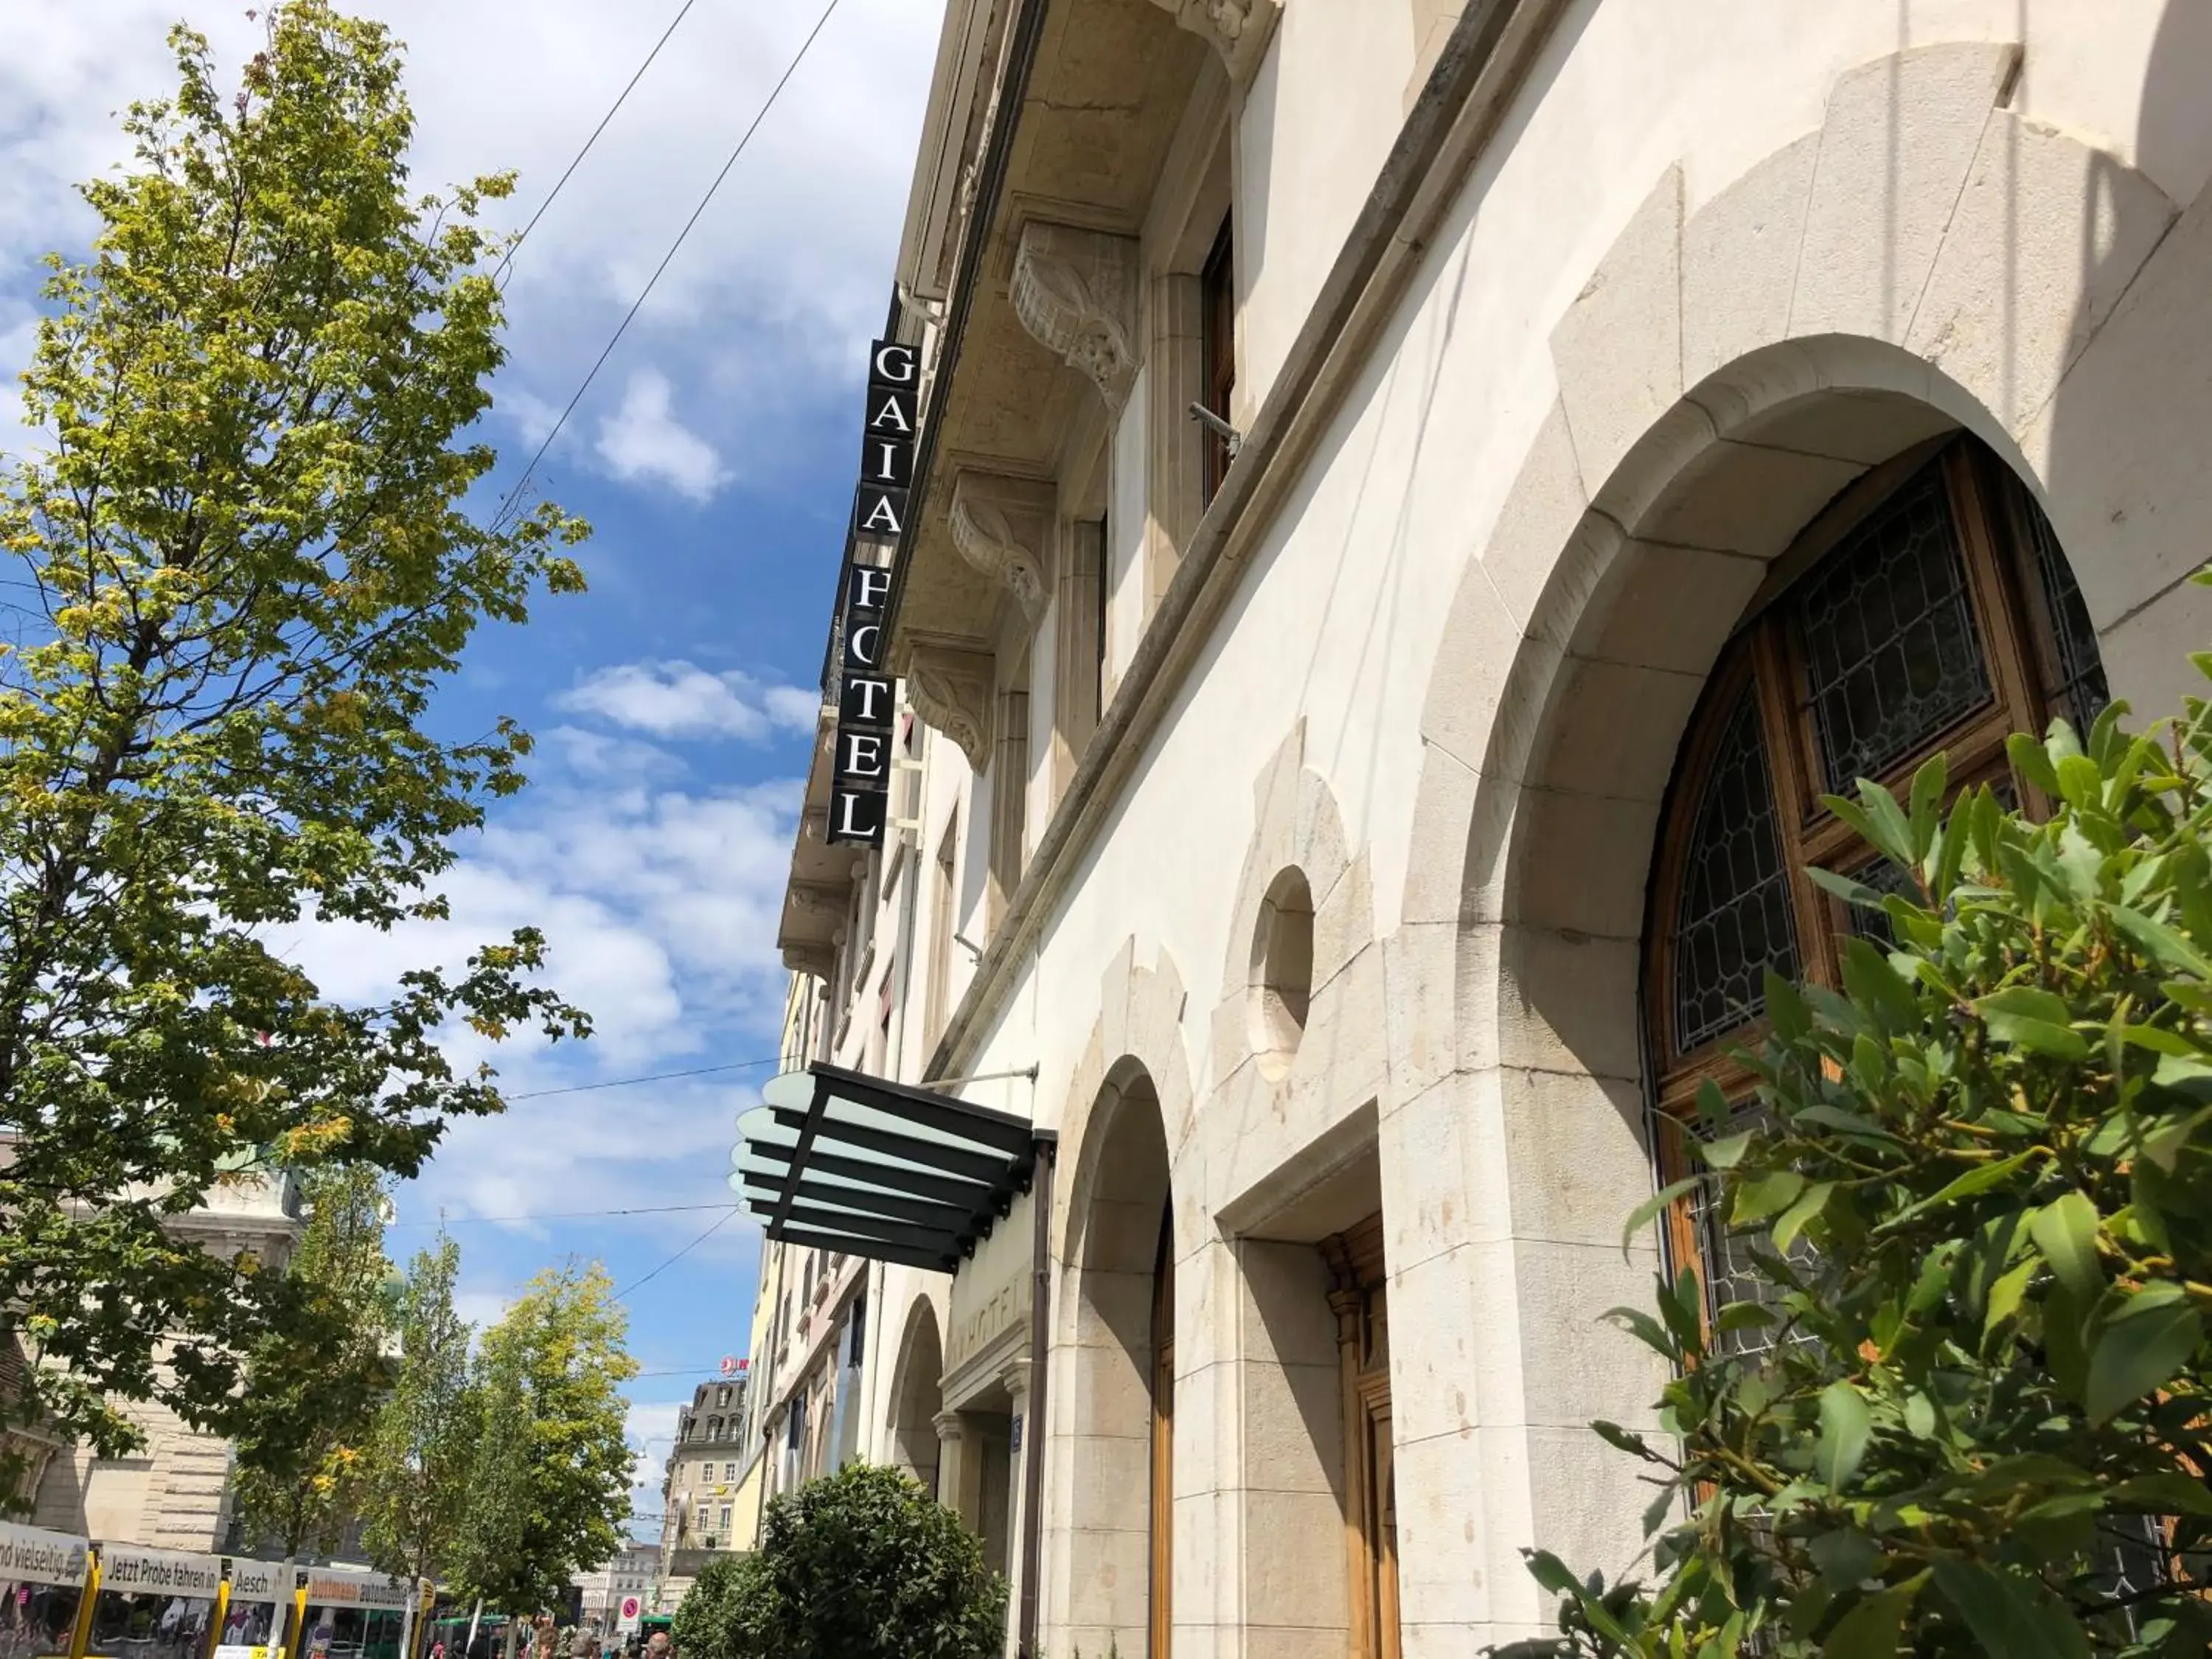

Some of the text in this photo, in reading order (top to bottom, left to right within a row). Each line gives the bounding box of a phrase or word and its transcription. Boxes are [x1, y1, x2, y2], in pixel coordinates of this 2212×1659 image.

[861, 345, 916, 533] GAIA
[108, 1555, 216, 1589] Jetzt Probe fahren in
[234, 1568, 268, 1593] Aesch
